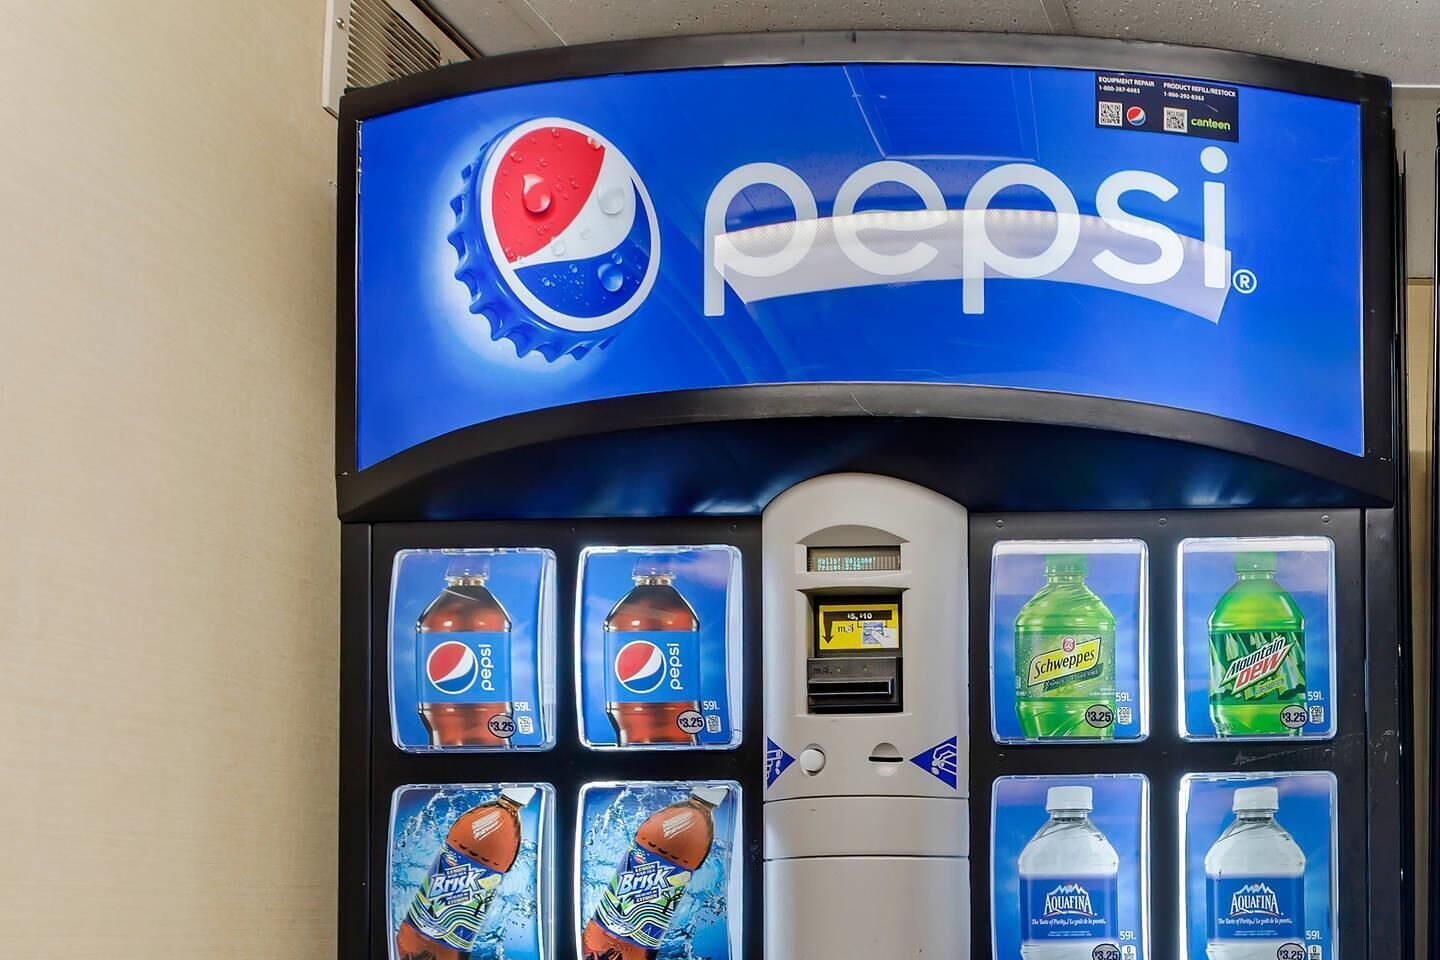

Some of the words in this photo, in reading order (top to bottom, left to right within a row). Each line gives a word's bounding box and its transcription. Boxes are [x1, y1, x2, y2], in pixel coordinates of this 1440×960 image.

[1098, 76, 1134, 85] EQUIPMENT
[1134, 79, 1155, 87] REPAIR
[1163, 82, 1191, 91] PRODUCT
[1191, 118, 1231, 131] canteen
[703, 146, 1231, 317] pepsi
[478, 643, 495, 691] pepsi
[667, 642, 683, 690] pepsi
[1033, 648, 1096, 680] Schweppes
[1226, 638, 1285, 679] Mountain
[680, 717, 704, 728] $3.25
[1087, 711, 1111, 722] $3.25
[1282, 712, 1306, 722] $3.25
[490, 721, 515, 732] $3.25
[429, 867, 486, 898] Brisk
[616, 866, 676, 896] Brisk
[1043, 892, 1094, 916] AQUAFINA
[1230, 891, 1280, 916] AQUAFINA
[1095, 950, 1118, 960] $3.25
[1280, 950, 1303, 960] $3.25
